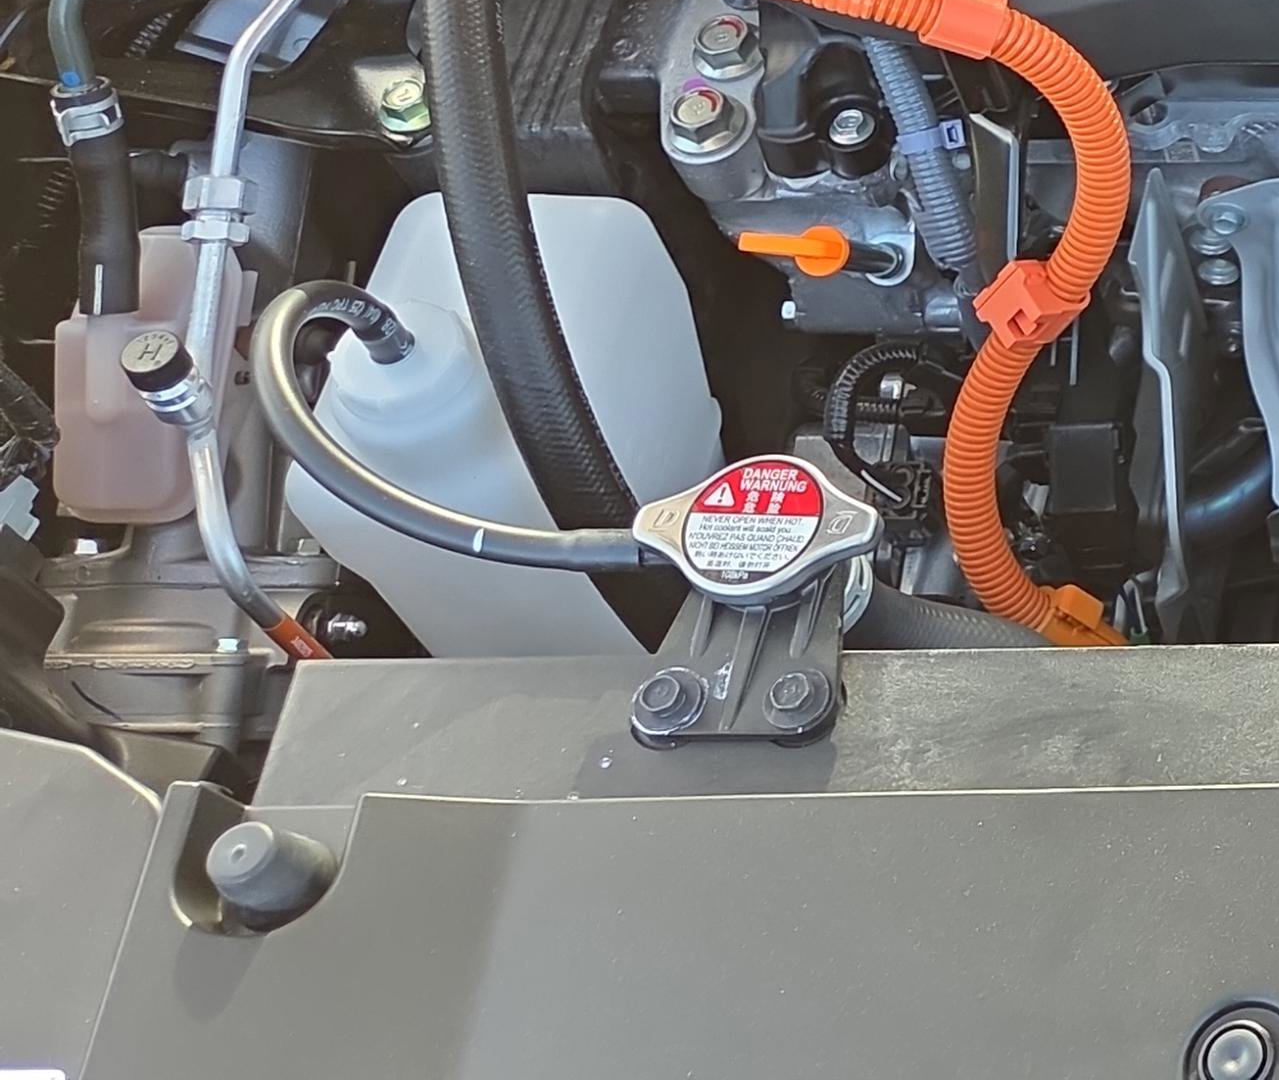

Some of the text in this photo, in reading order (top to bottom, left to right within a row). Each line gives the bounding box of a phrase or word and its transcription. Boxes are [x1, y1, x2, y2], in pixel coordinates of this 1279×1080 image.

[742, 468, 798, 480] DANGER
[739, 479, 808, 493] WARNUNG
[701, 515, 728, 525] NEVER
[729, 516, 756, 525] OPEN
[757, 517, 782, 525] WHEN
[730, 532, 749, 541] PAS
